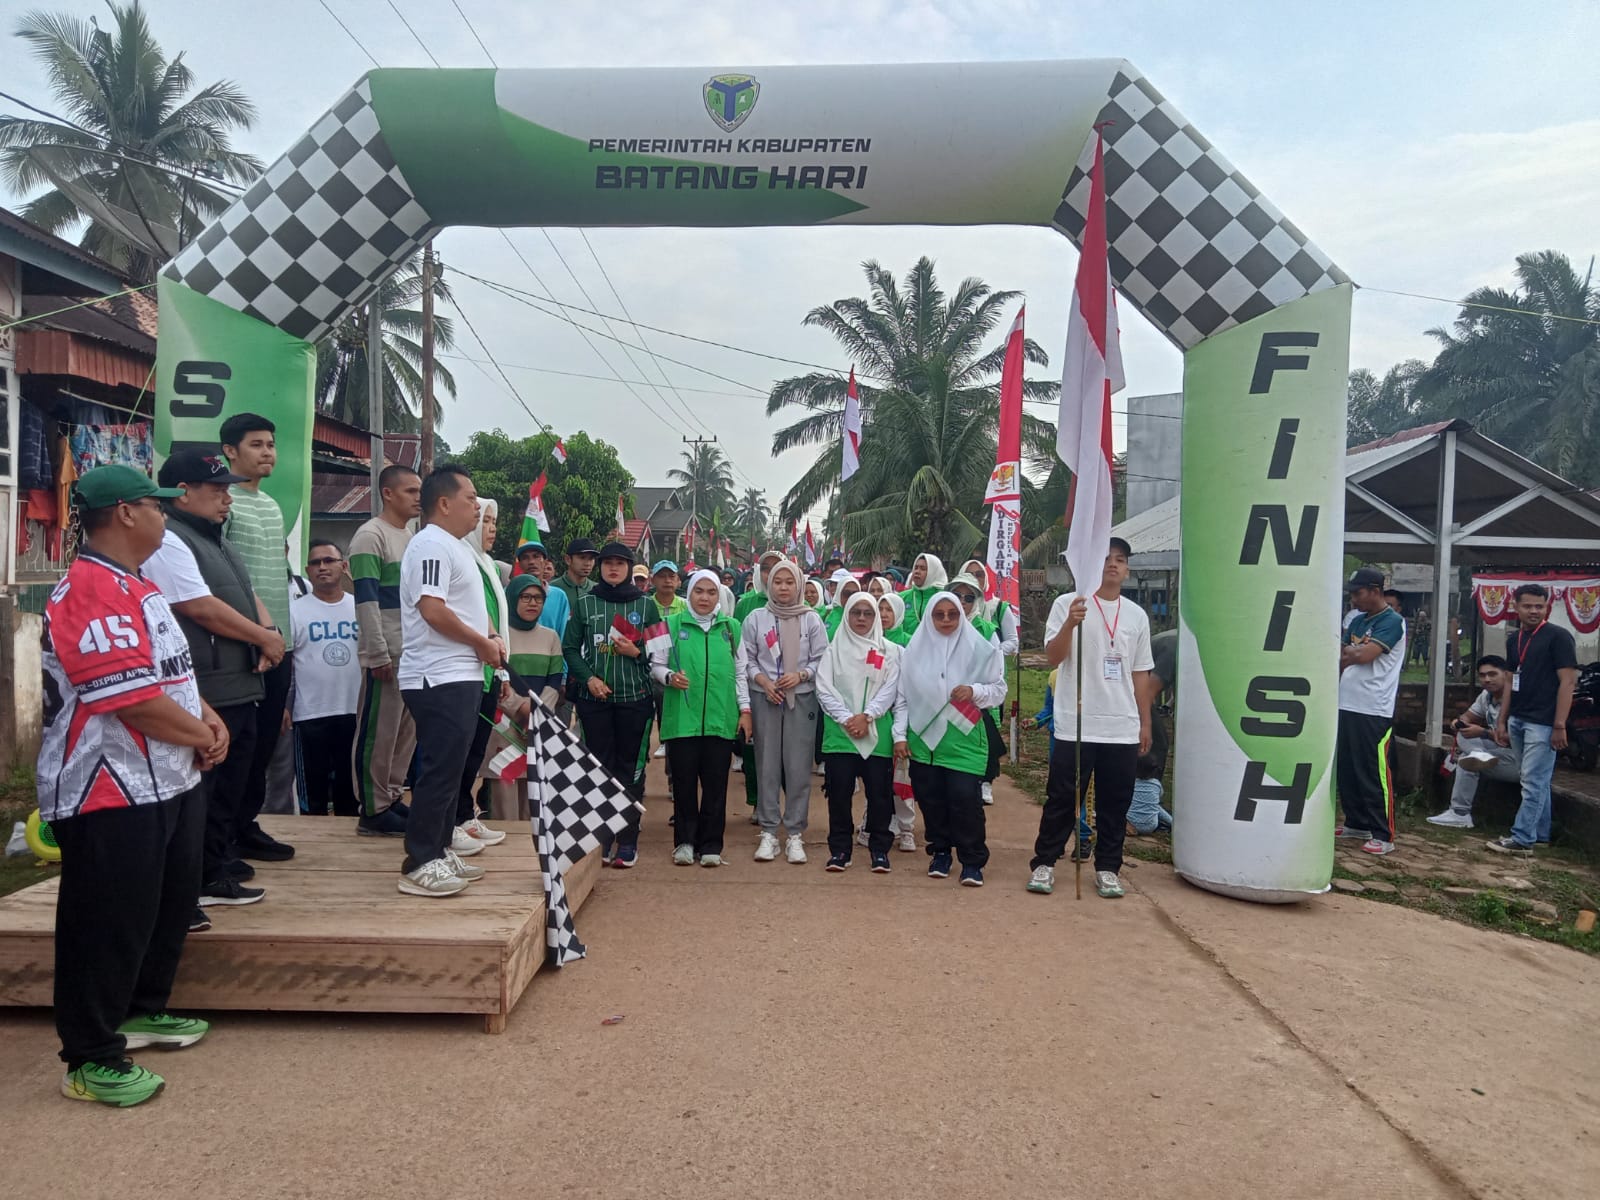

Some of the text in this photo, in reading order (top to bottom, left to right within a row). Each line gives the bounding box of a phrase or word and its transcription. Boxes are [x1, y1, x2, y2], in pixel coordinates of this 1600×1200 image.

[588, 138, 872, 153] PEMERINTAH KABUPATEN
[595, 165, 869, 190] BATANG HARI
[1233, 331, 1321, 825] FINISH
[78, 614, 140, 655] 45
